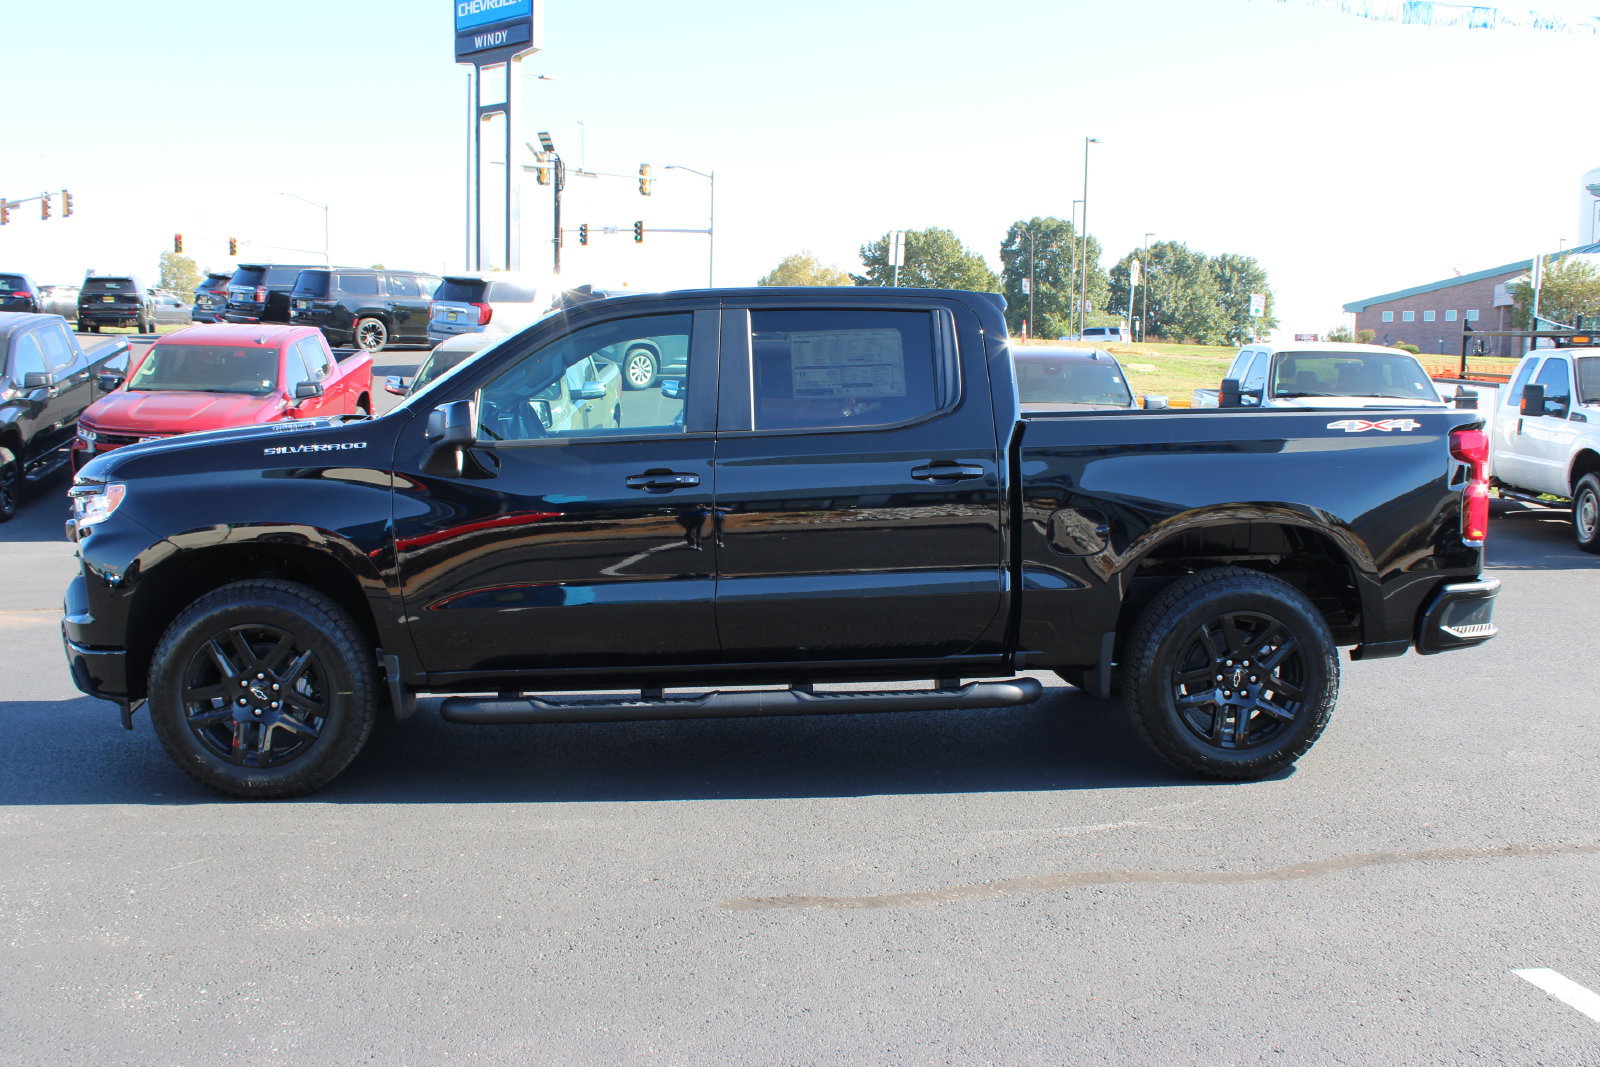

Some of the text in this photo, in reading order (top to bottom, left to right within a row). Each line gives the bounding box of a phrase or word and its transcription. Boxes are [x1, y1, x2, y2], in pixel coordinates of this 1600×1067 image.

[458, 0, 522, 17] CHEVROL
[474, 30, 508, 49] WINDY
[263, 442, 367, 455] SILVERADO
